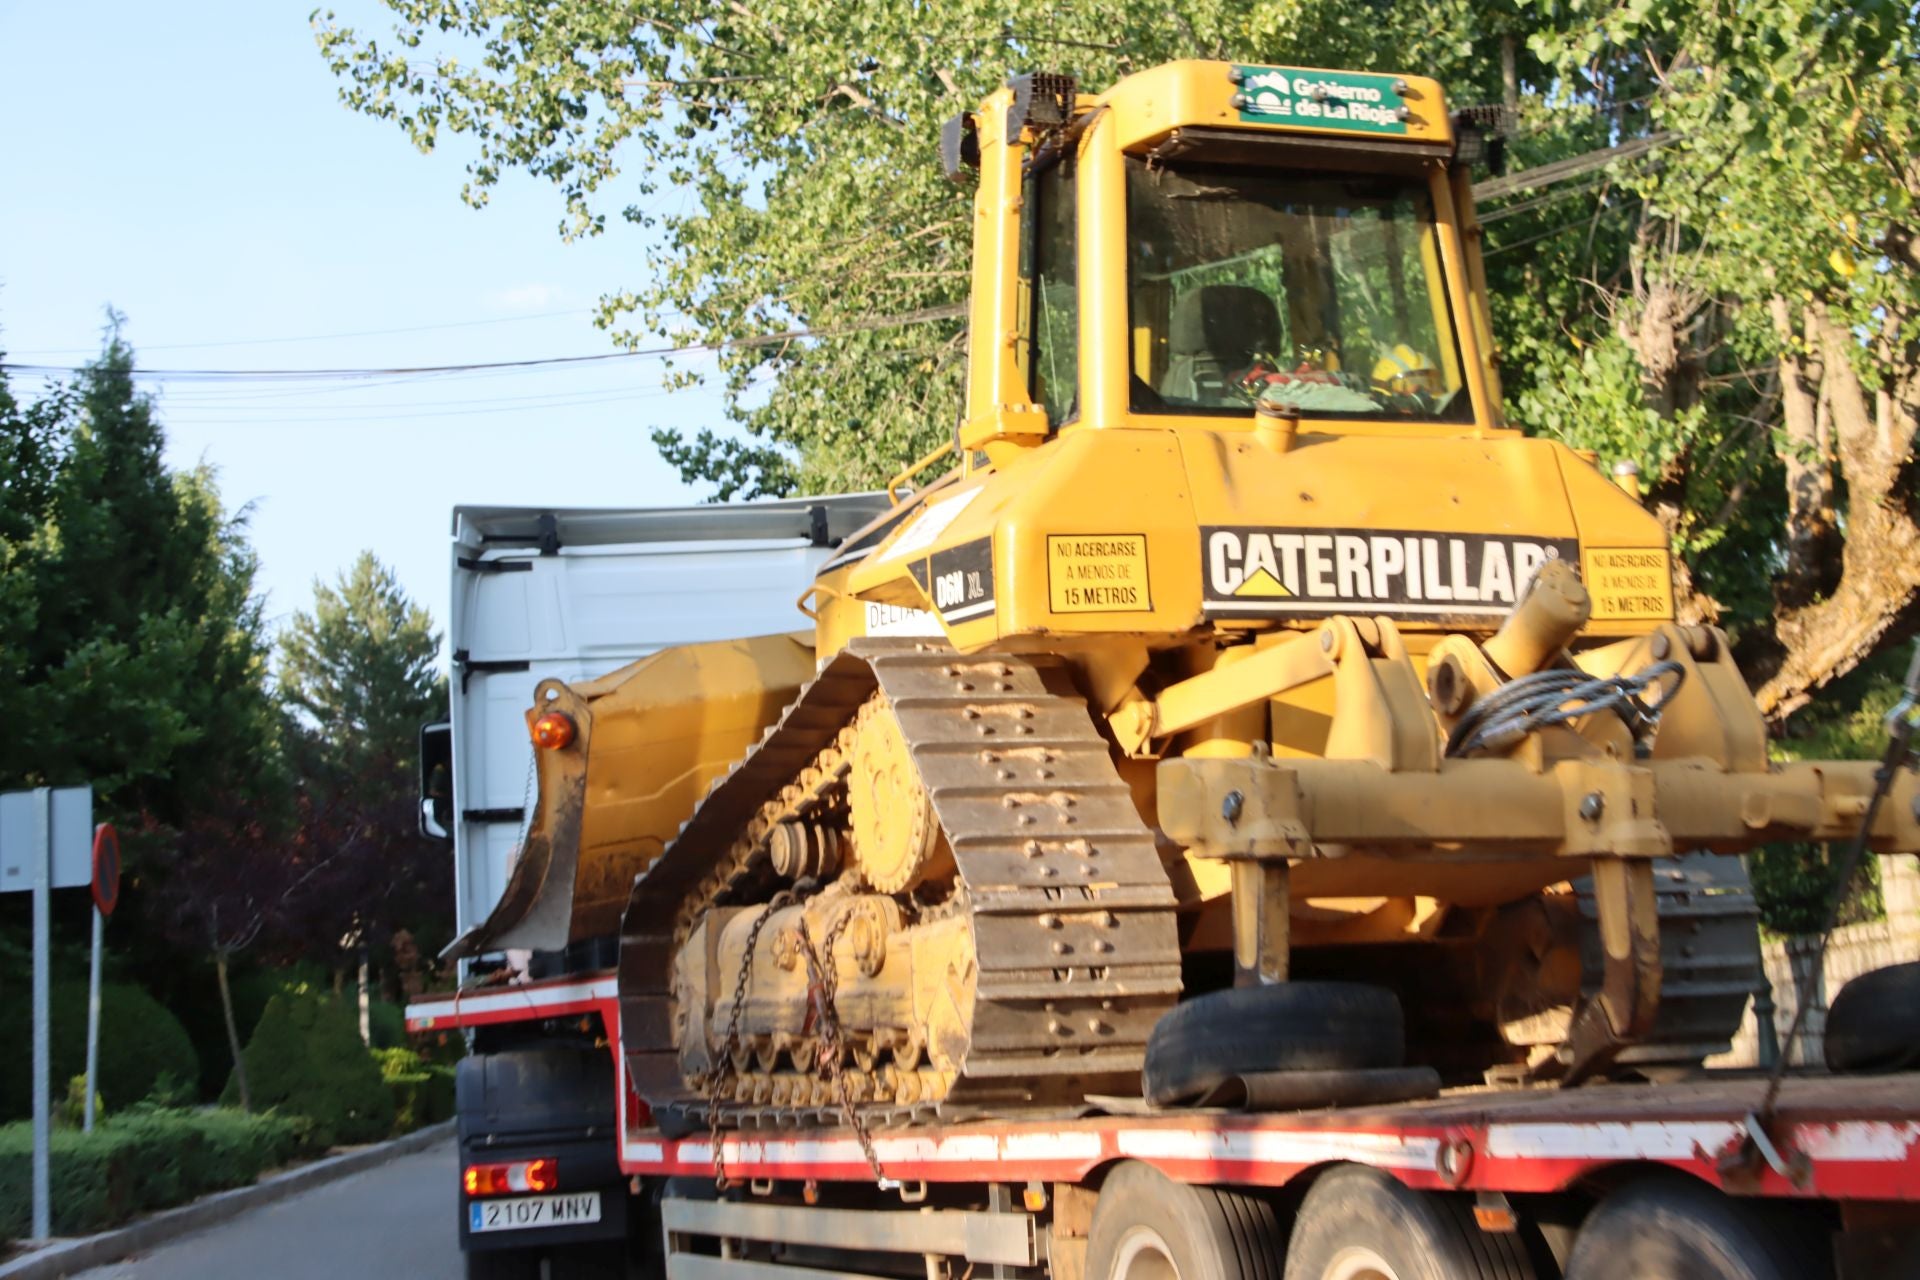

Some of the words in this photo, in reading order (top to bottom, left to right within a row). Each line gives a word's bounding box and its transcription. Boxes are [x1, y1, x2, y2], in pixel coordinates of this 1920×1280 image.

[1295, 98, 1321, 117] de
[1323, 101, 1348, 119] La
[1348, 101, 1398, 126] Rioja
[1057, 543, 1072, 557] NO
[1075, 542, 1137, 557] ACERCARSE
[1067, 565, 1074, 580] A
[1078, 564, 1115, 580] MENOS
[1118, 564, 1131, 579] DE
[1208, 531, 1547, 602] CATERPILLAR
[936, 570, 965, 609] D6N
[967, 571, 984, 600] XL
[1065, 588, 1080, 606] 15
[1084, 587, 1137, 605] METROS
[487, 1202, 544, 1226] 2107
[552, 1197, 594, 1220] MNV
